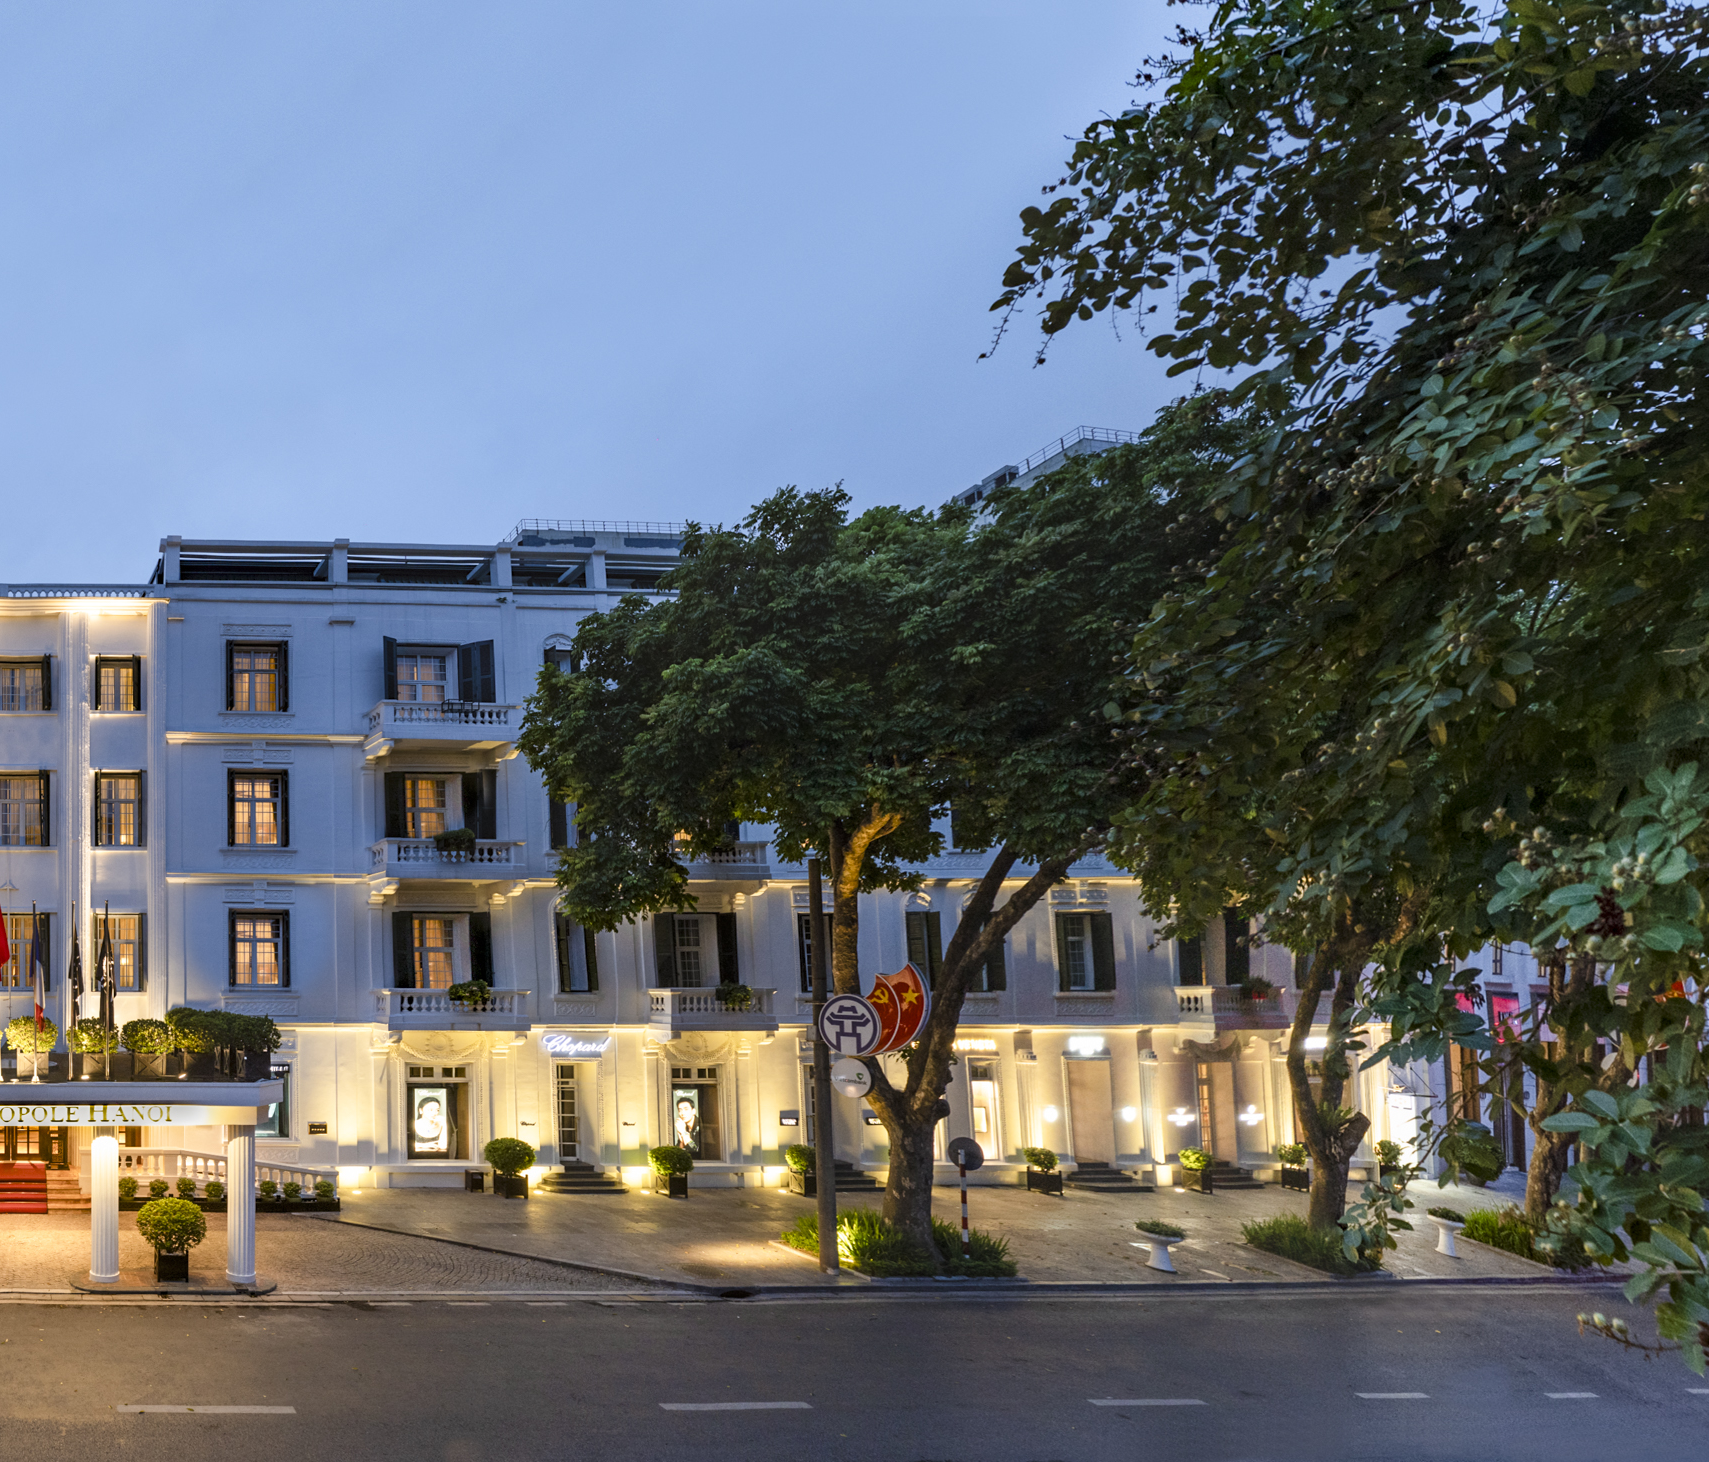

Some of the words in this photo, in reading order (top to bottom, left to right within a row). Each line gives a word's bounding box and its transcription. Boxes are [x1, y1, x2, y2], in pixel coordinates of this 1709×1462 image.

[542, 1034, 612, 1055] Chopard
[834, 1076, 867, 1086] Vetcombank
[87, 1104, 173, 1123] HANOI
